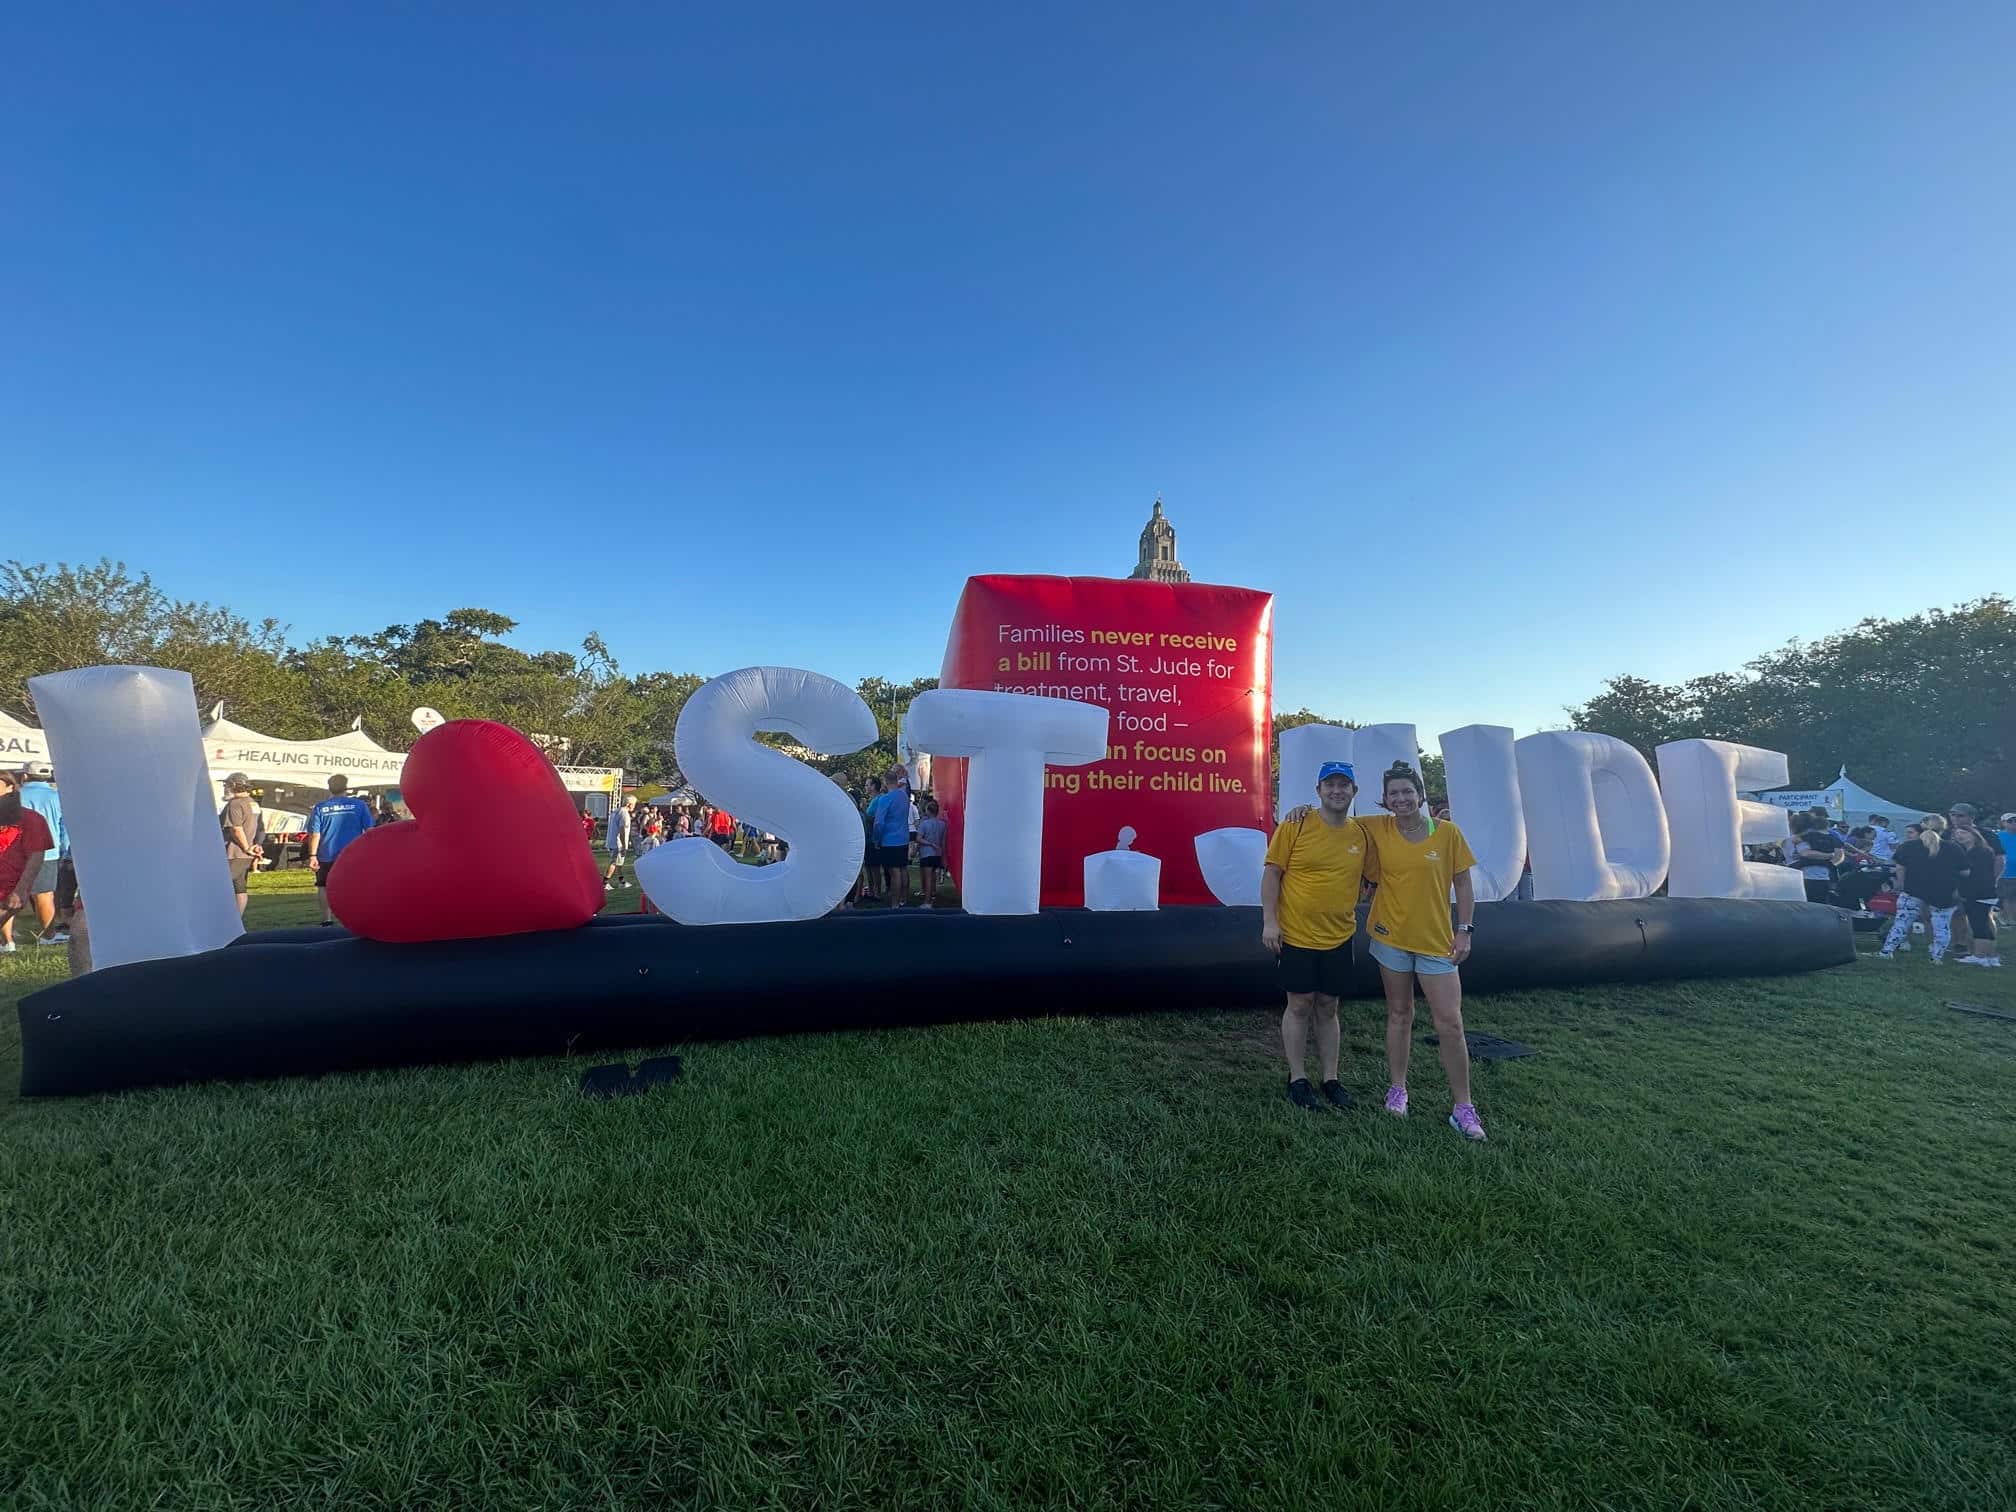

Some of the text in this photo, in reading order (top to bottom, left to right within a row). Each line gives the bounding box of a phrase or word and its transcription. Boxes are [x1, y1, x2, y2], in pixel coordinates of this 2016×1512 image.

[998, 625, 1237, 652] Families never receive
[998, 652, 1234, 679] a bill from St. Jude for
[1118, 683, 1182, 706] travel,
[1117, 710, 1167, 732] food
[237, 750, 309, 765] HEALING
[314, 754, 378, 769] THROUGH
[1134, 739, 1195, 762] focus
[1201, 747, 1228, 764] on
[1087, 769, 1144, 791] their
[1150, 771, 1204, 793] child
[1209, 772, 1247, 793] live.
